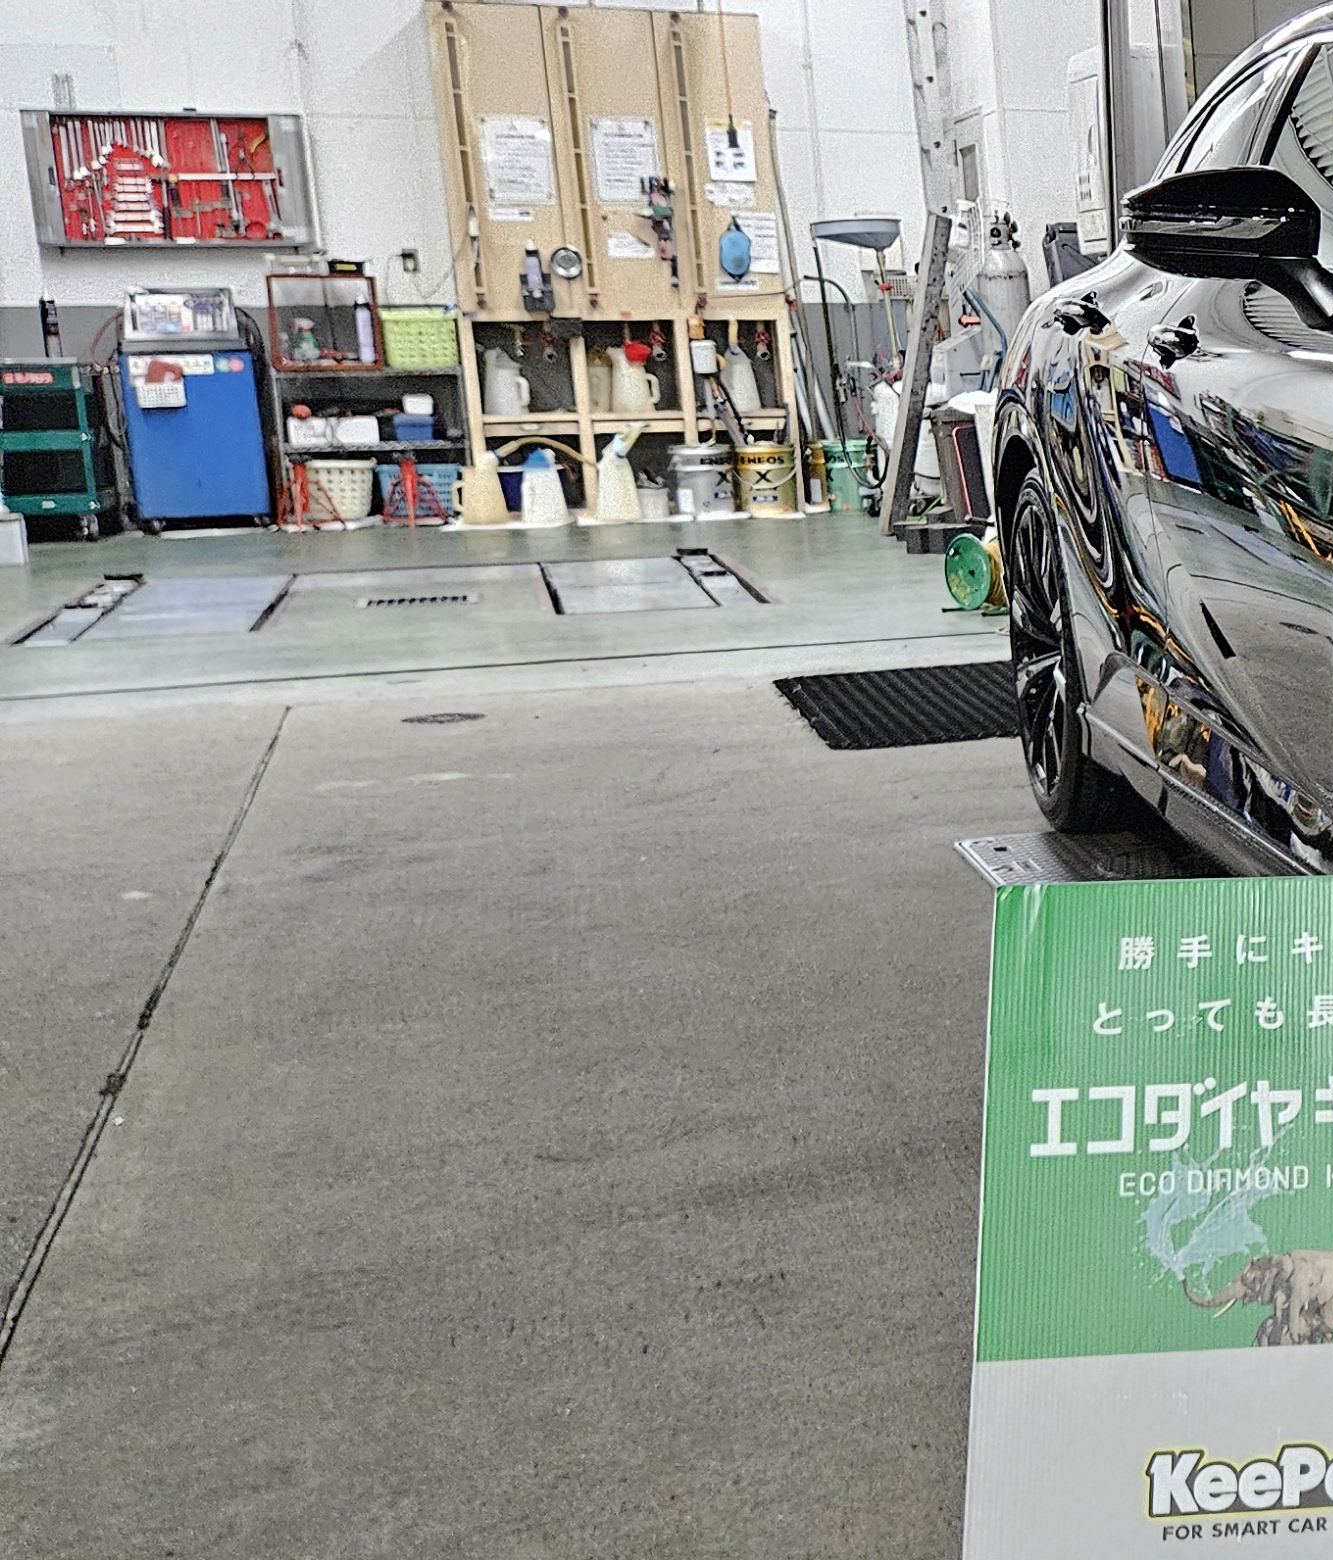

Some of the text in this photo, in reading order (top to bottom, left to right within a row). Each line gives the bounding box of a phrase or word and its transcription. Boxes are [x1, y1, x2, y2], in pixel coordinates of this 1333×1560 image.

[1119, 1171, 1175, 1198] ECO
[1187, 1165, 1309, 1196] DIAMOND
[1162, 1525, 1203, 1542] FOR
[1212, 1519, 1281, 1538] SMART
[1288, 1516, 1327, 1534] CAR
